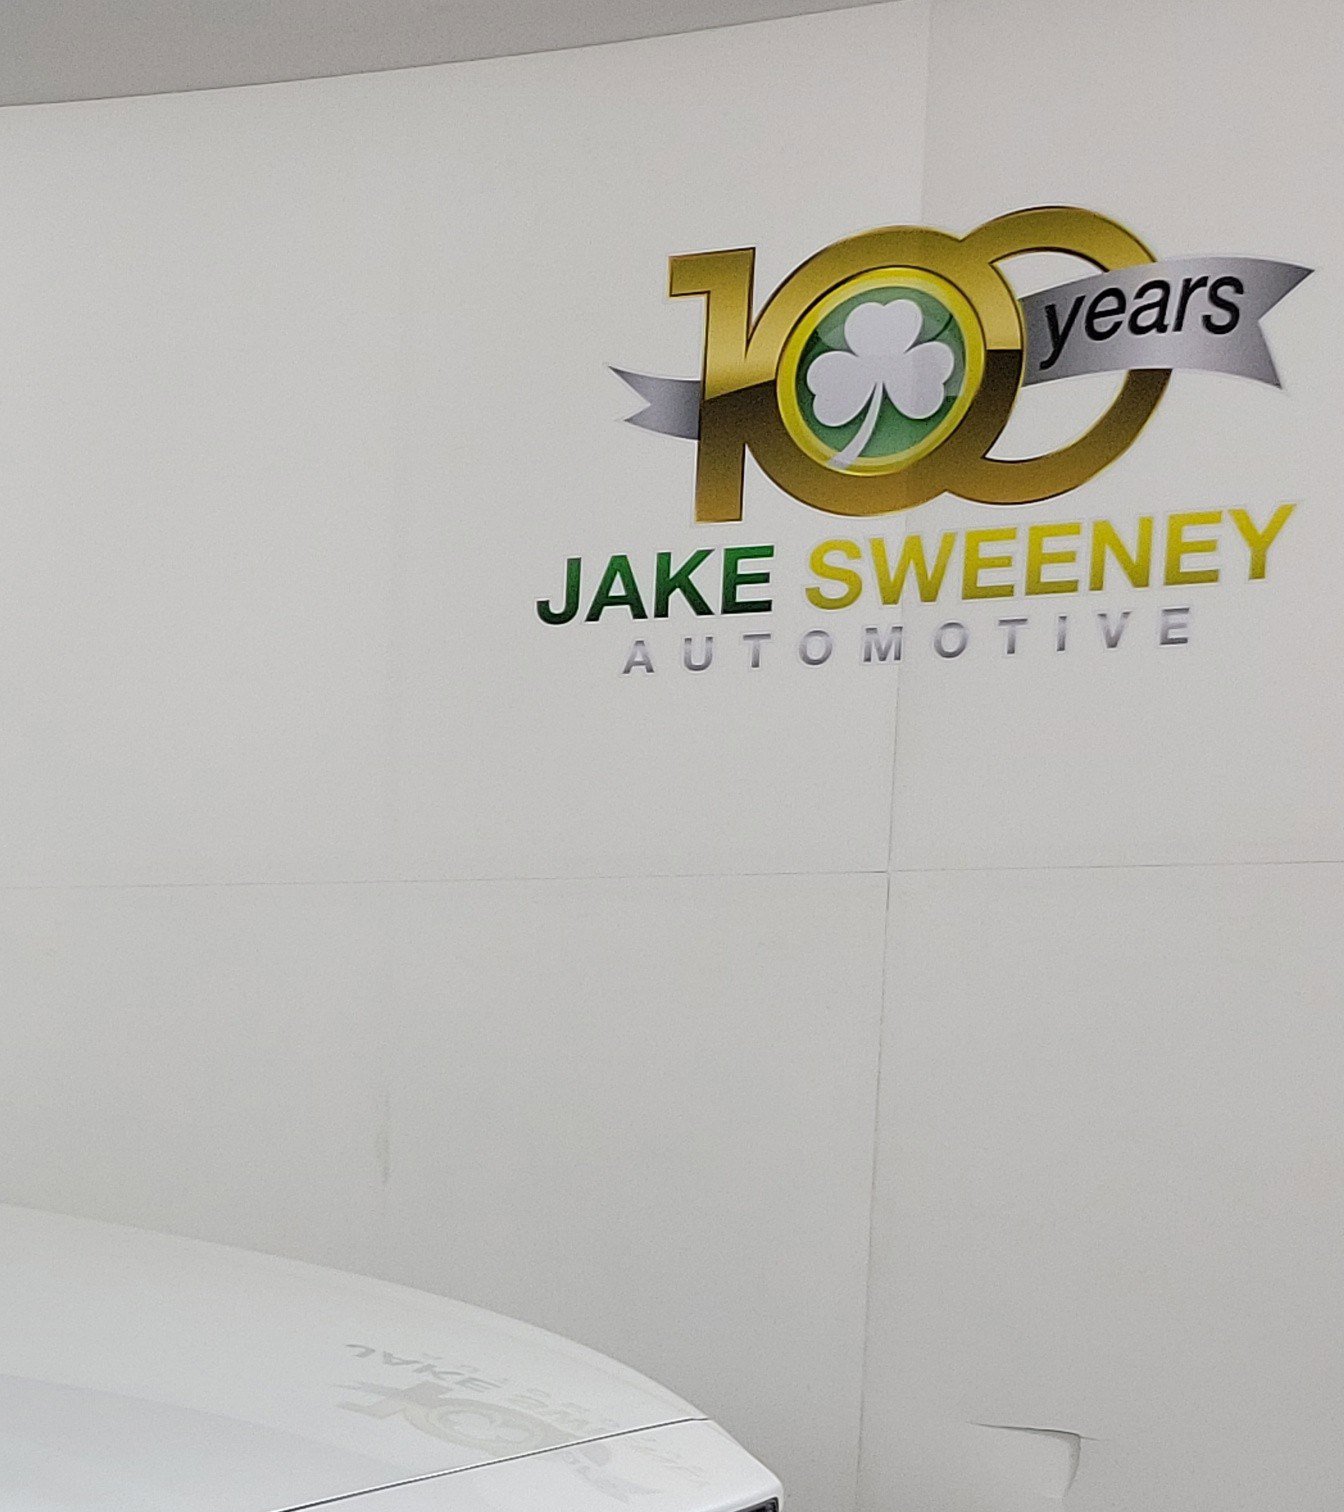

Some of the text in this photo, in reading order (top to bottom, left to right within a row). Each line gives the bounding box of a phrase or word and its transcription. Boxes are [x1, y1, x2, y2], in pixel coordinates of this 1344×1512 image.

[1040, 273, 1244, 370] years
[536, 503, 1298, 627] JAKE SWEENEY
[622, 607, 1192, 676] AUTOMOTIVE
